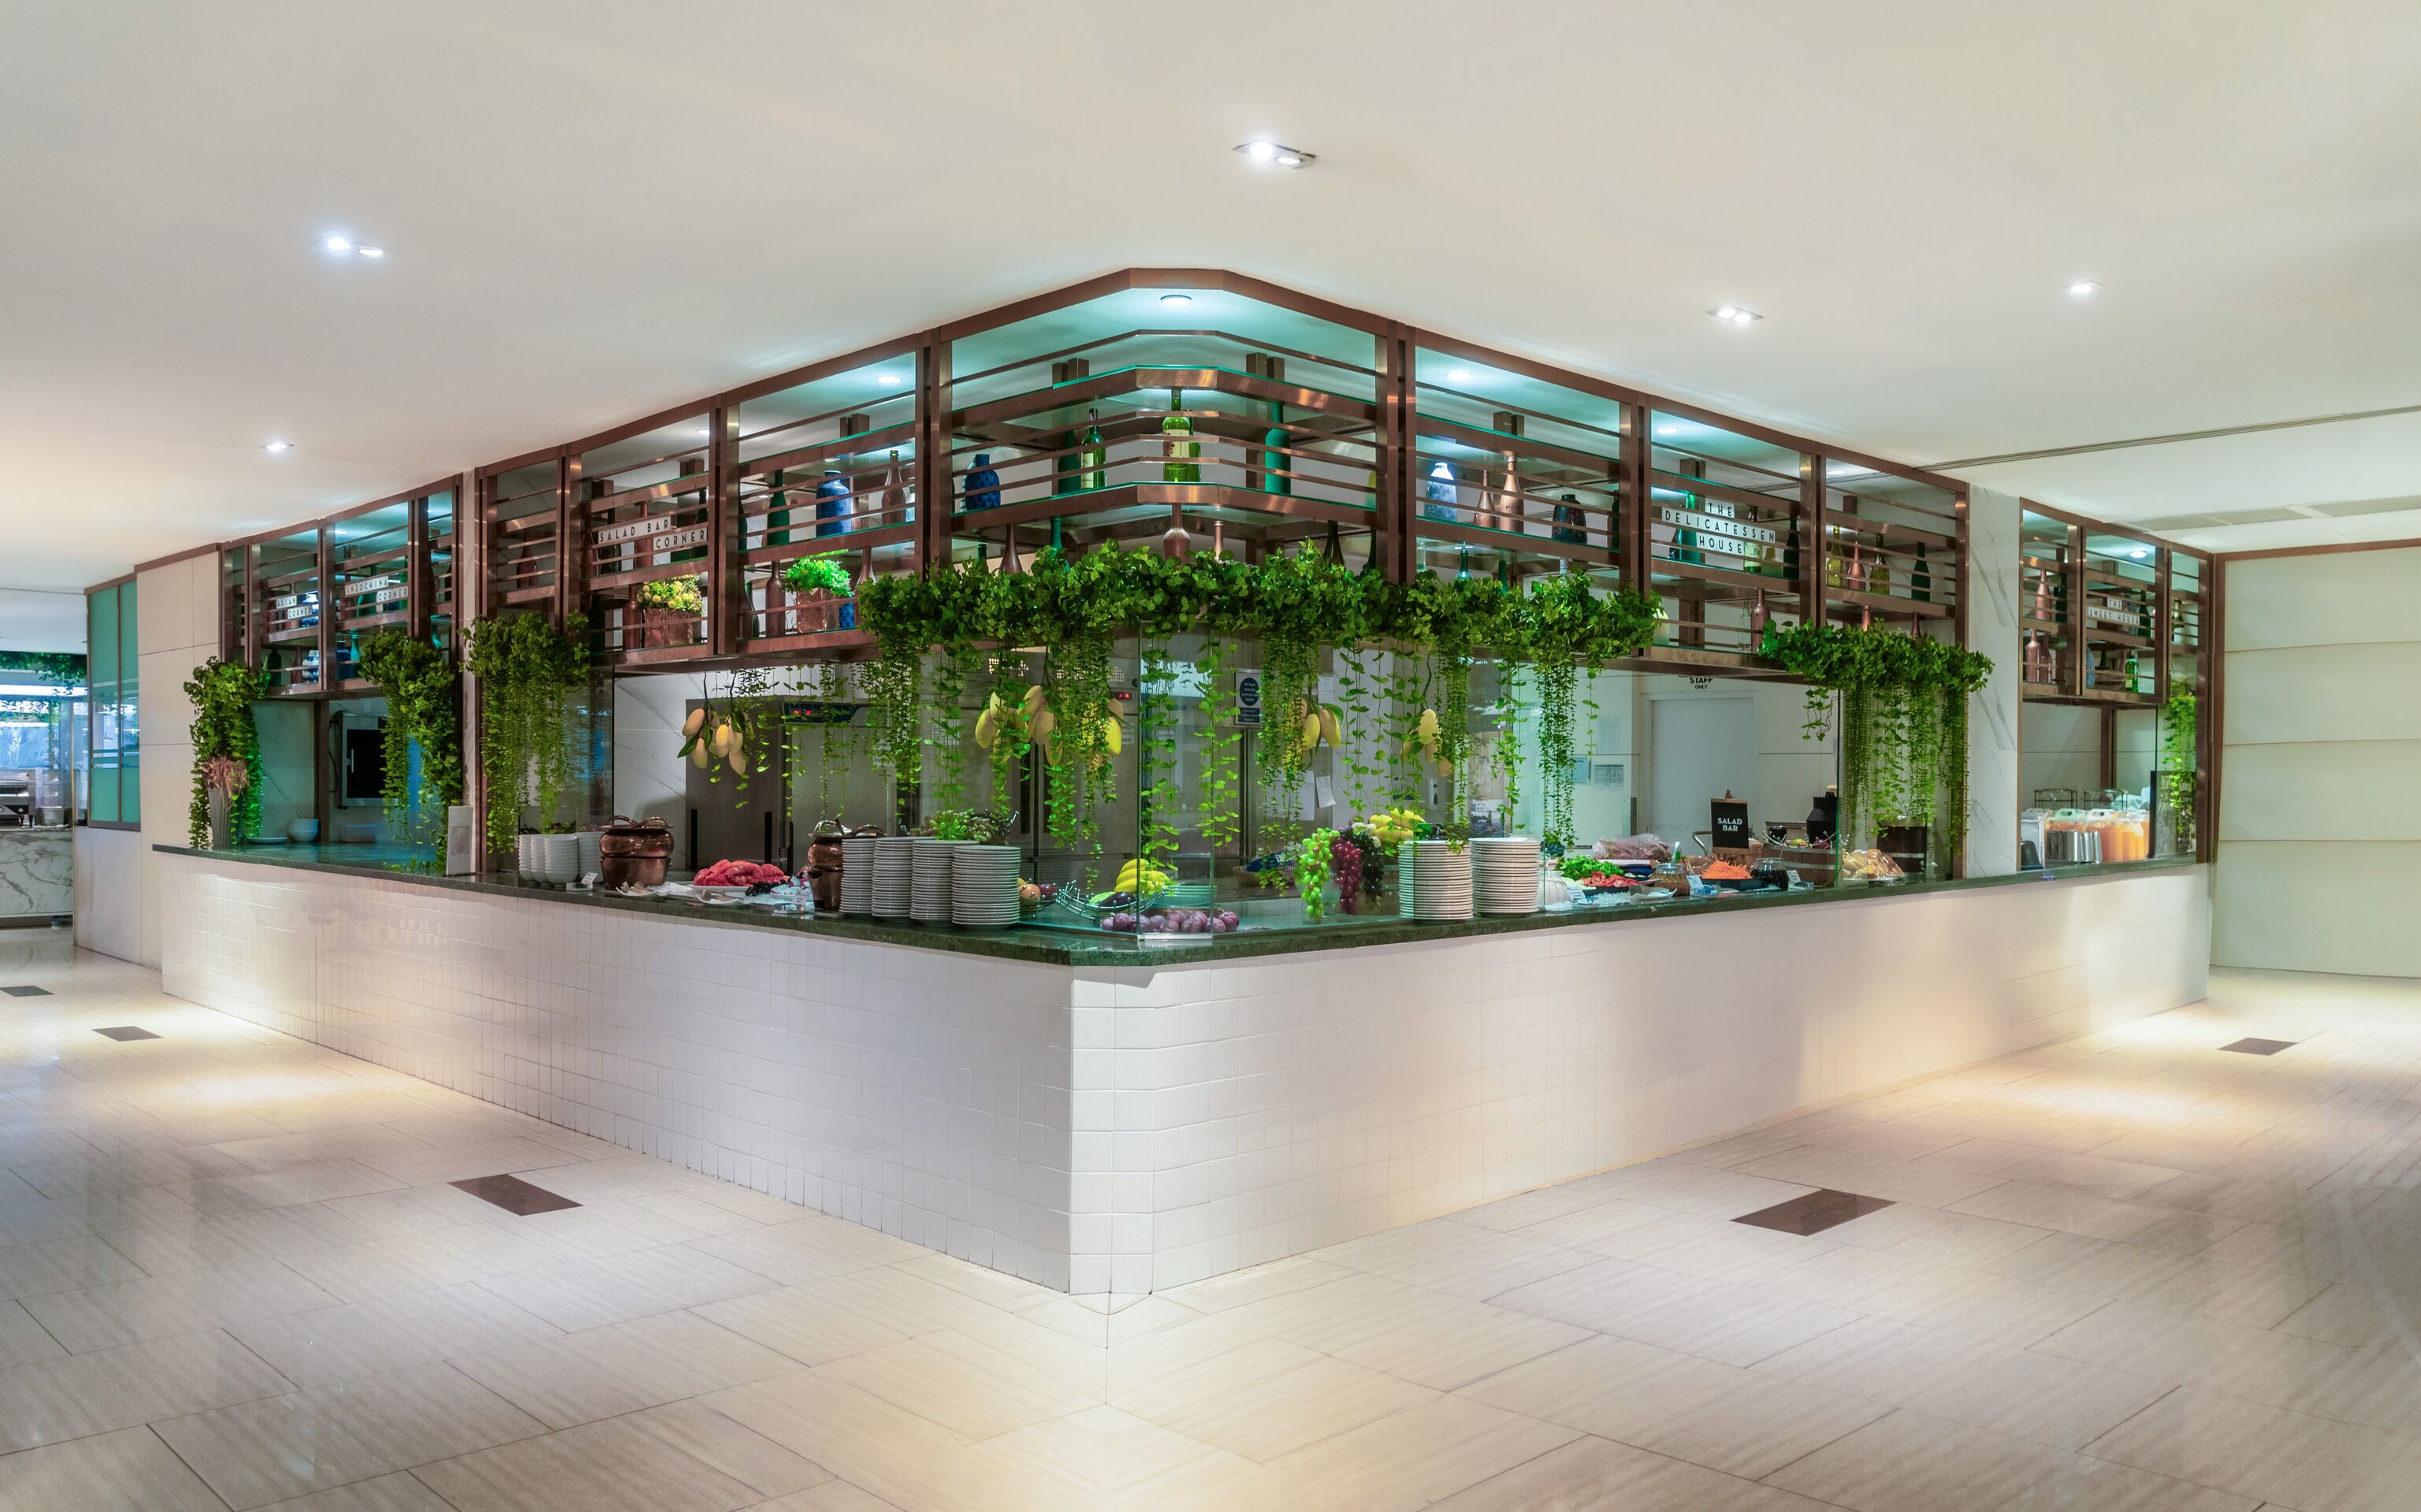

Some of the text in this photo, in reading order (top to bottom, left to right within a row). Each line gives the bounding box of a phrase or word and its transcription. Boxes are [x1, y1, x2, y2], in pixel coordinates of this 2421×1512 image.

[1709, 503, 1732, 517] THE
[600, 518, 669, 543] SALAD BAR
[1665, 510, 1774, 541] DELICATESSEN
[656, 529, 705, 549] CORNER
[1699, 535, 1742, 554] HOUSE
[347, 579, 388, 594] INDOCHINA
[378, 588, 407, 601] CORNER
[277, 597, 296, 607] ASIAN
[2109, 599, 2122, 609] THE
[288, 606, 312, 619] CORNER
